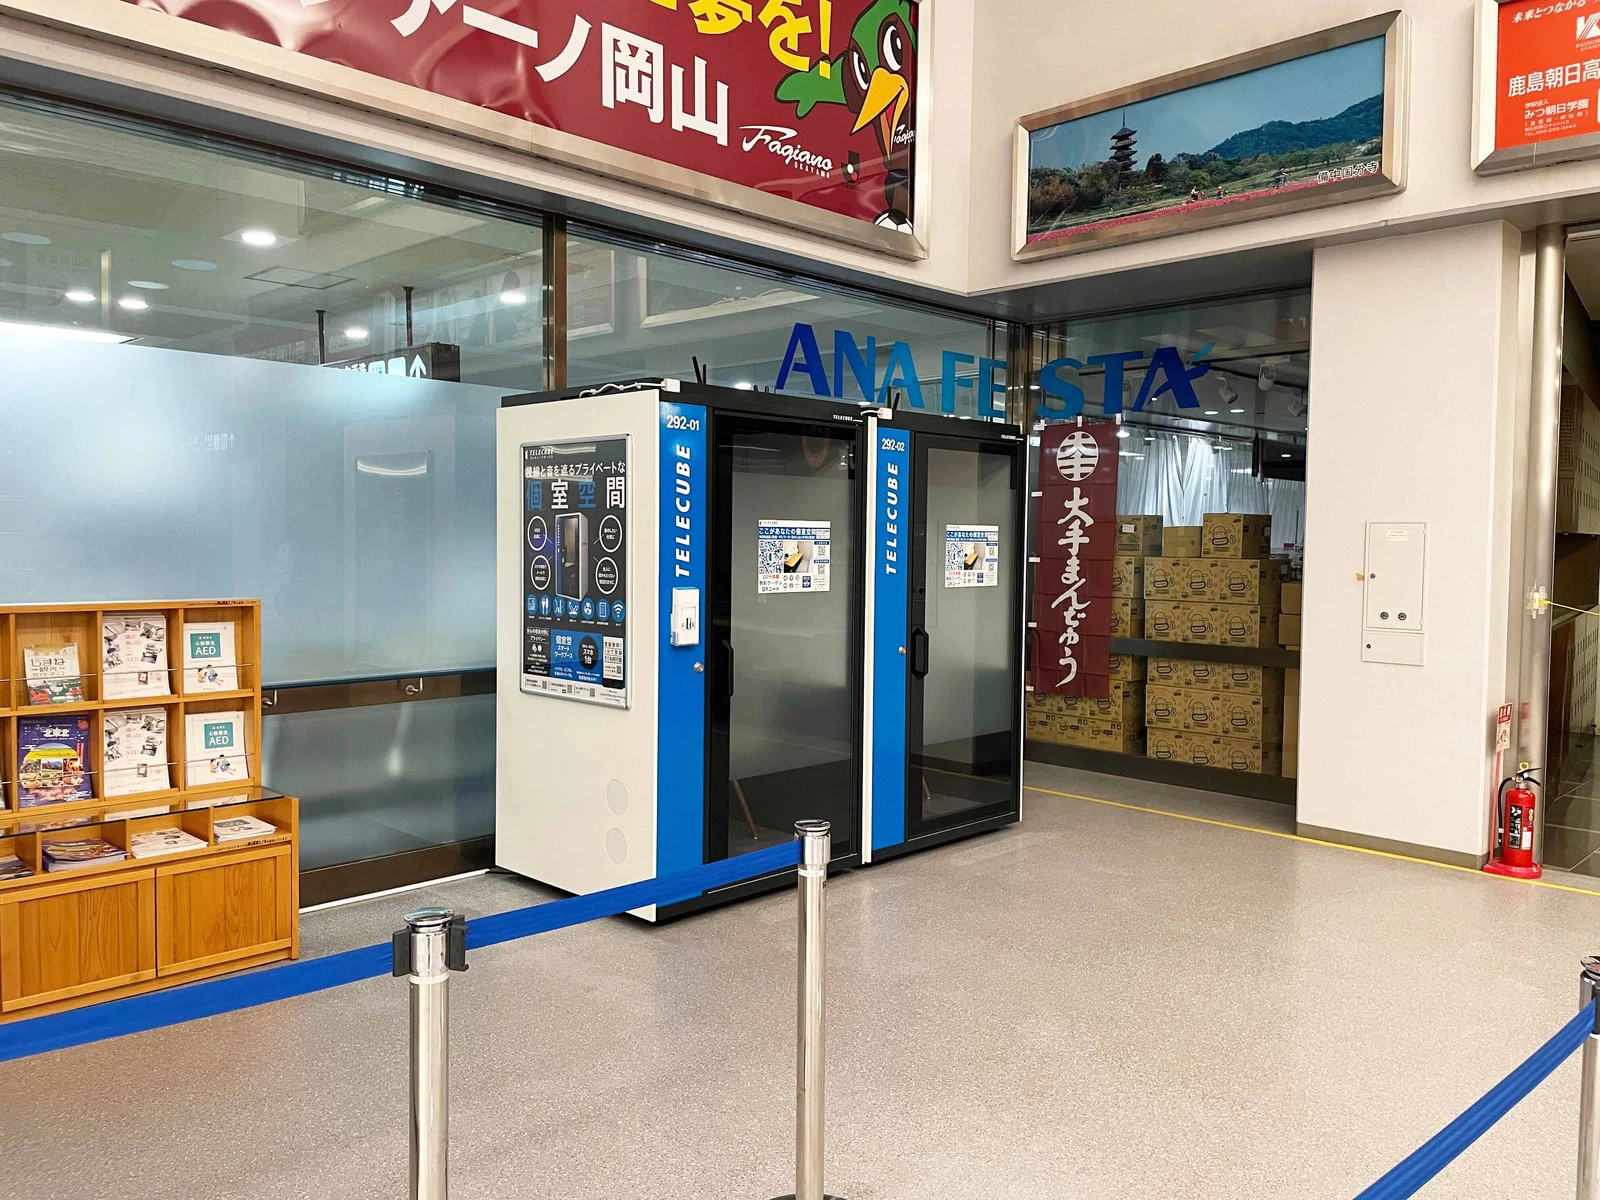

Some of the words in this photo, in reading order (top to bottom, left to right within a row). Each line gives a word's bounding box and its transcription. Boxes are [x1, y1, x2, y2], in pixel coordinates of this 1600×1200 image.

[1524, 98, 1589, 119] みつ朝日学園
[739, 125, 833, 171] Fagiano
[794, 161, 831, 179] OKAYAMA
[1316, 161, 1379, 184] 備中国分寺
[775, 322, 925, 410] ANA
[666, 414, 700, 431] 292-01
[881, 438, 905, 452] 292-02
[526, 476, 626, 511] 個室空間
[675, 444, 691, 578] TELECUBE
[885, 462, 898, 575] TELECUBE
[195, 646, 217, 656] AED
[208, 736, 230, 746] AED
